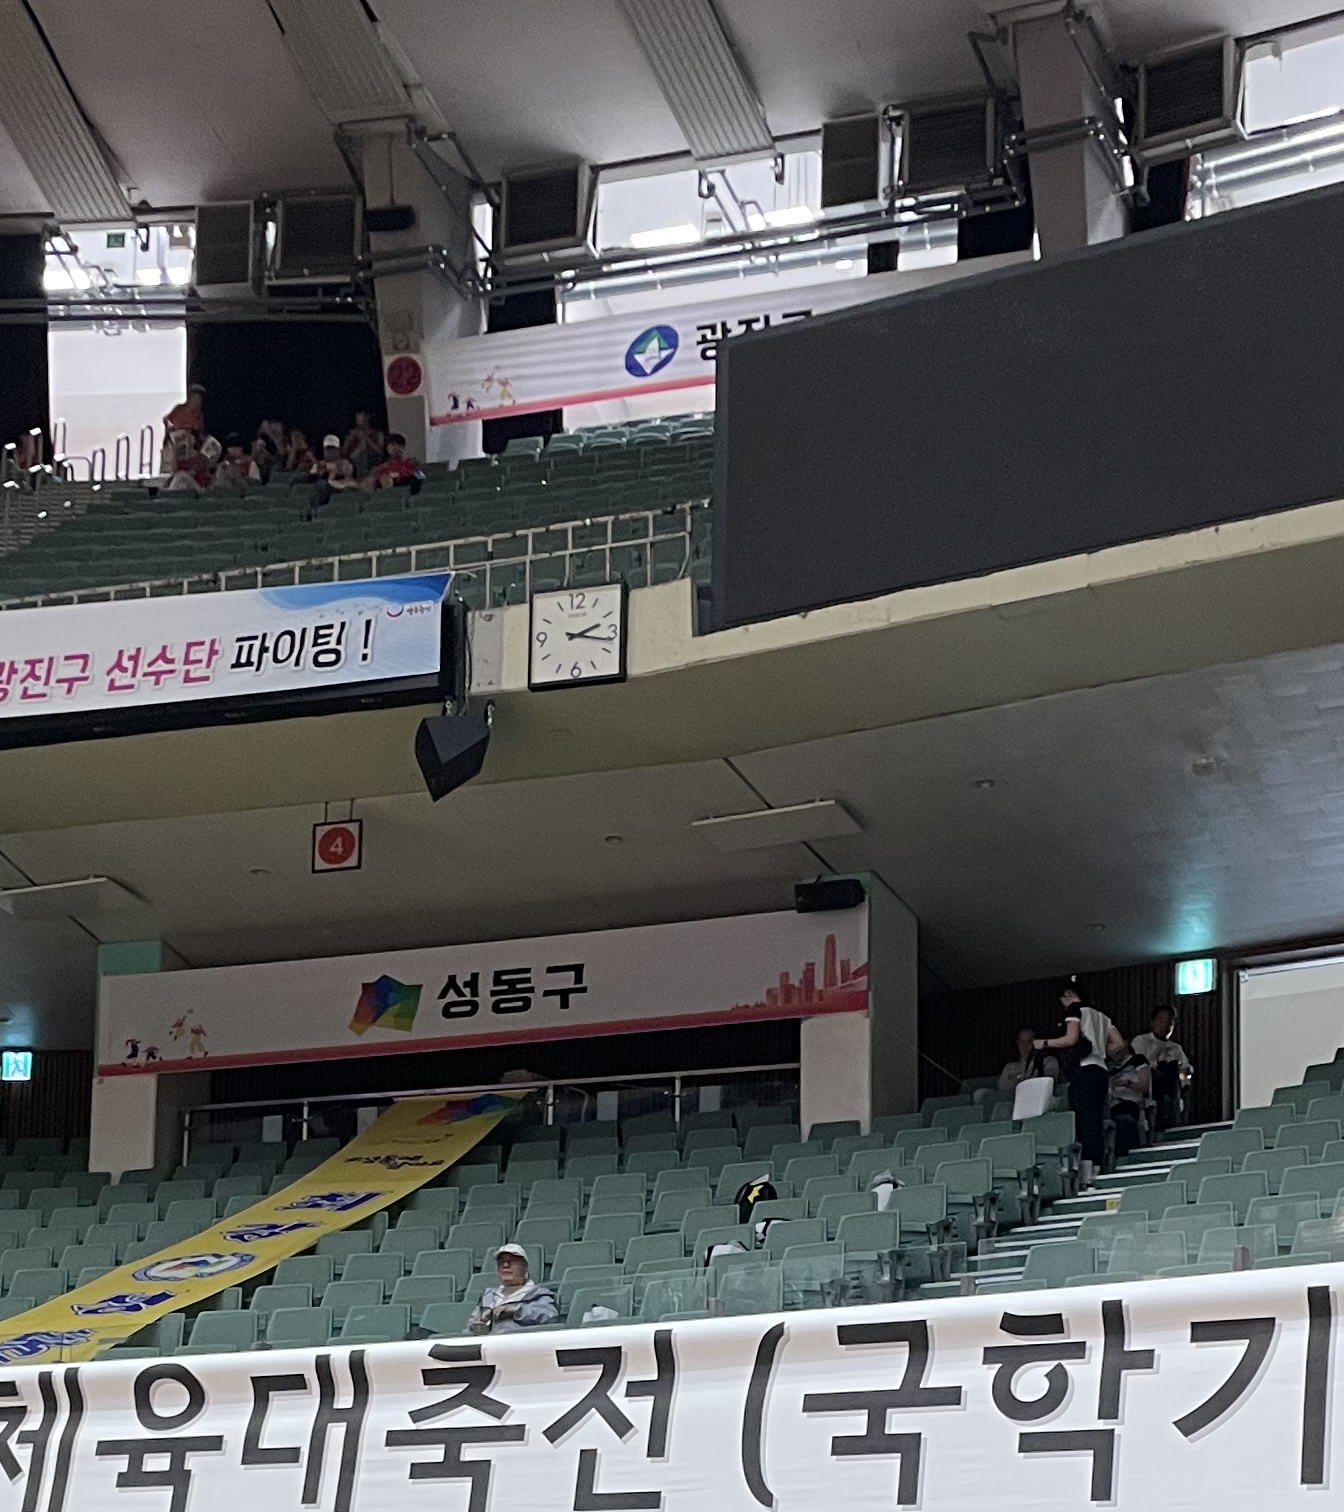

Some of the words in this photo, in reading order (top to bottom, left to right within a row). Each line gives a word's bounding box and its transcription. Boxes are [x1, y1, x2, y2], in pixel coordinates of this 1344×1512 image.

[568, 592, 586, 609] 12
[536, 632, 547, 647] 9
[608, 623, 618, 639] 3
[106, 638, 220, 695] 선수단
[230, 621, 350, 675] 파이팅
[570, 662, 582, 678] 6
[329, 837, 344, 856] 4
[436, 962, 590, 1022] 성동구
